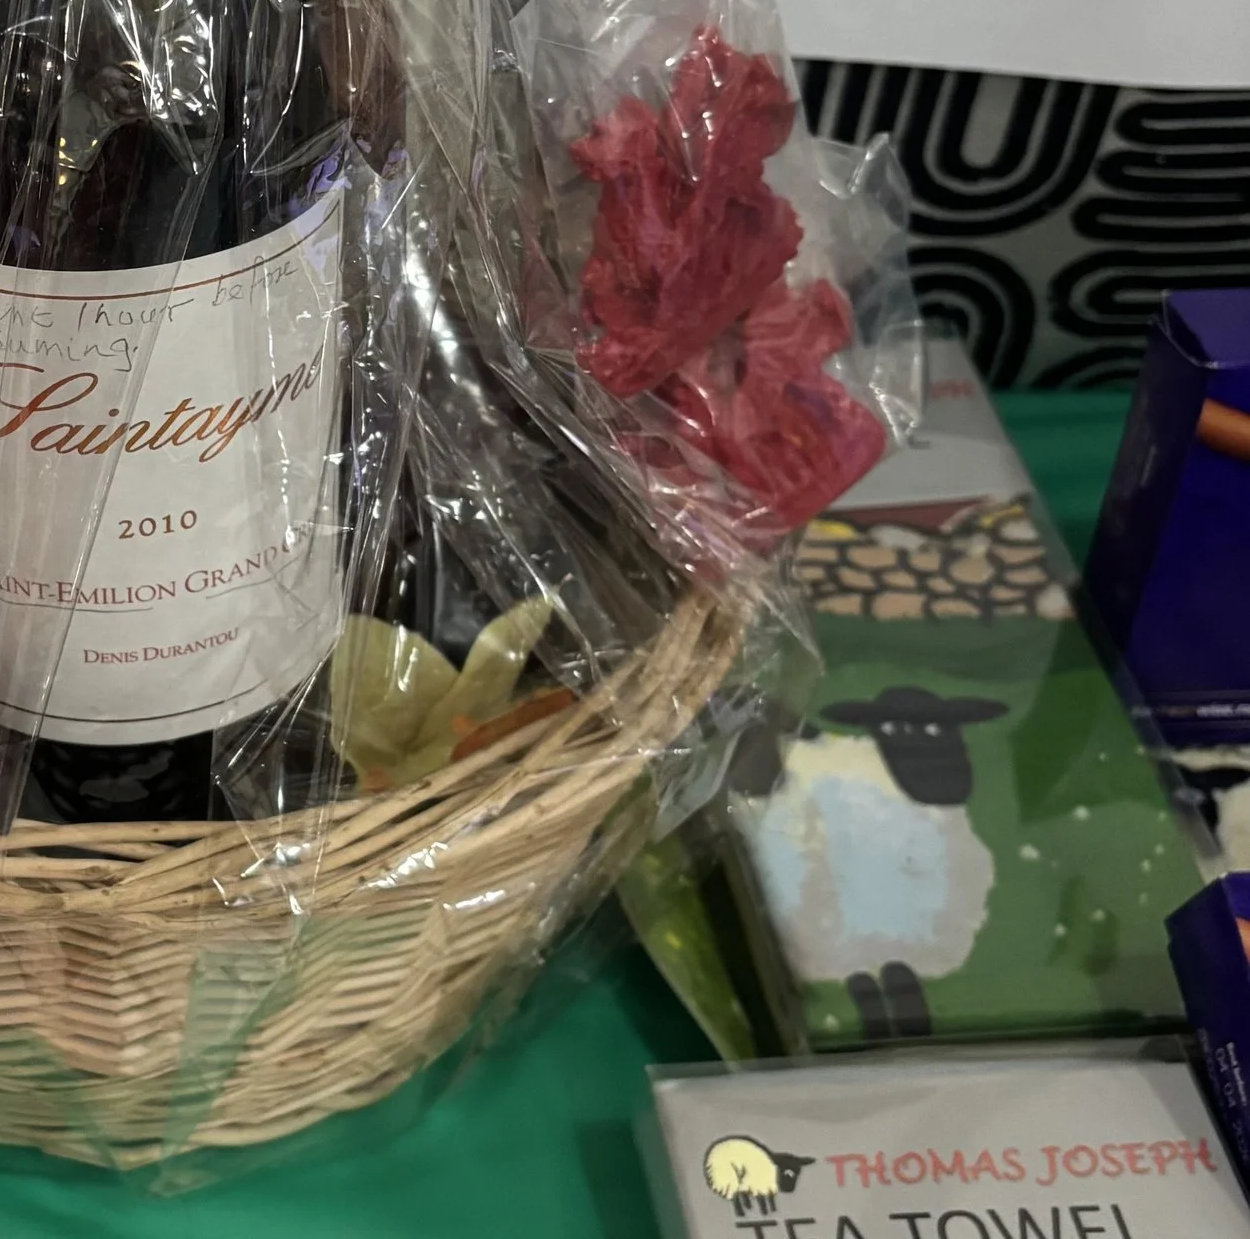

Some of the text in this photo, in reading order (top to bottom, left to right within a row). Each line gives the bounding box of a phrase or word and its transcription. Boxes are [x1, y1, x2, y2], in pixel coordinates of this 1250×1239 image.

[117, 508, 198, 541] 2010
[184, 545, 278, 594] GRAND
[83, 627, 241, 664] DENIS DURANTOU
[825, 1137, 1219, 1190] THOMAS JOSEPH
